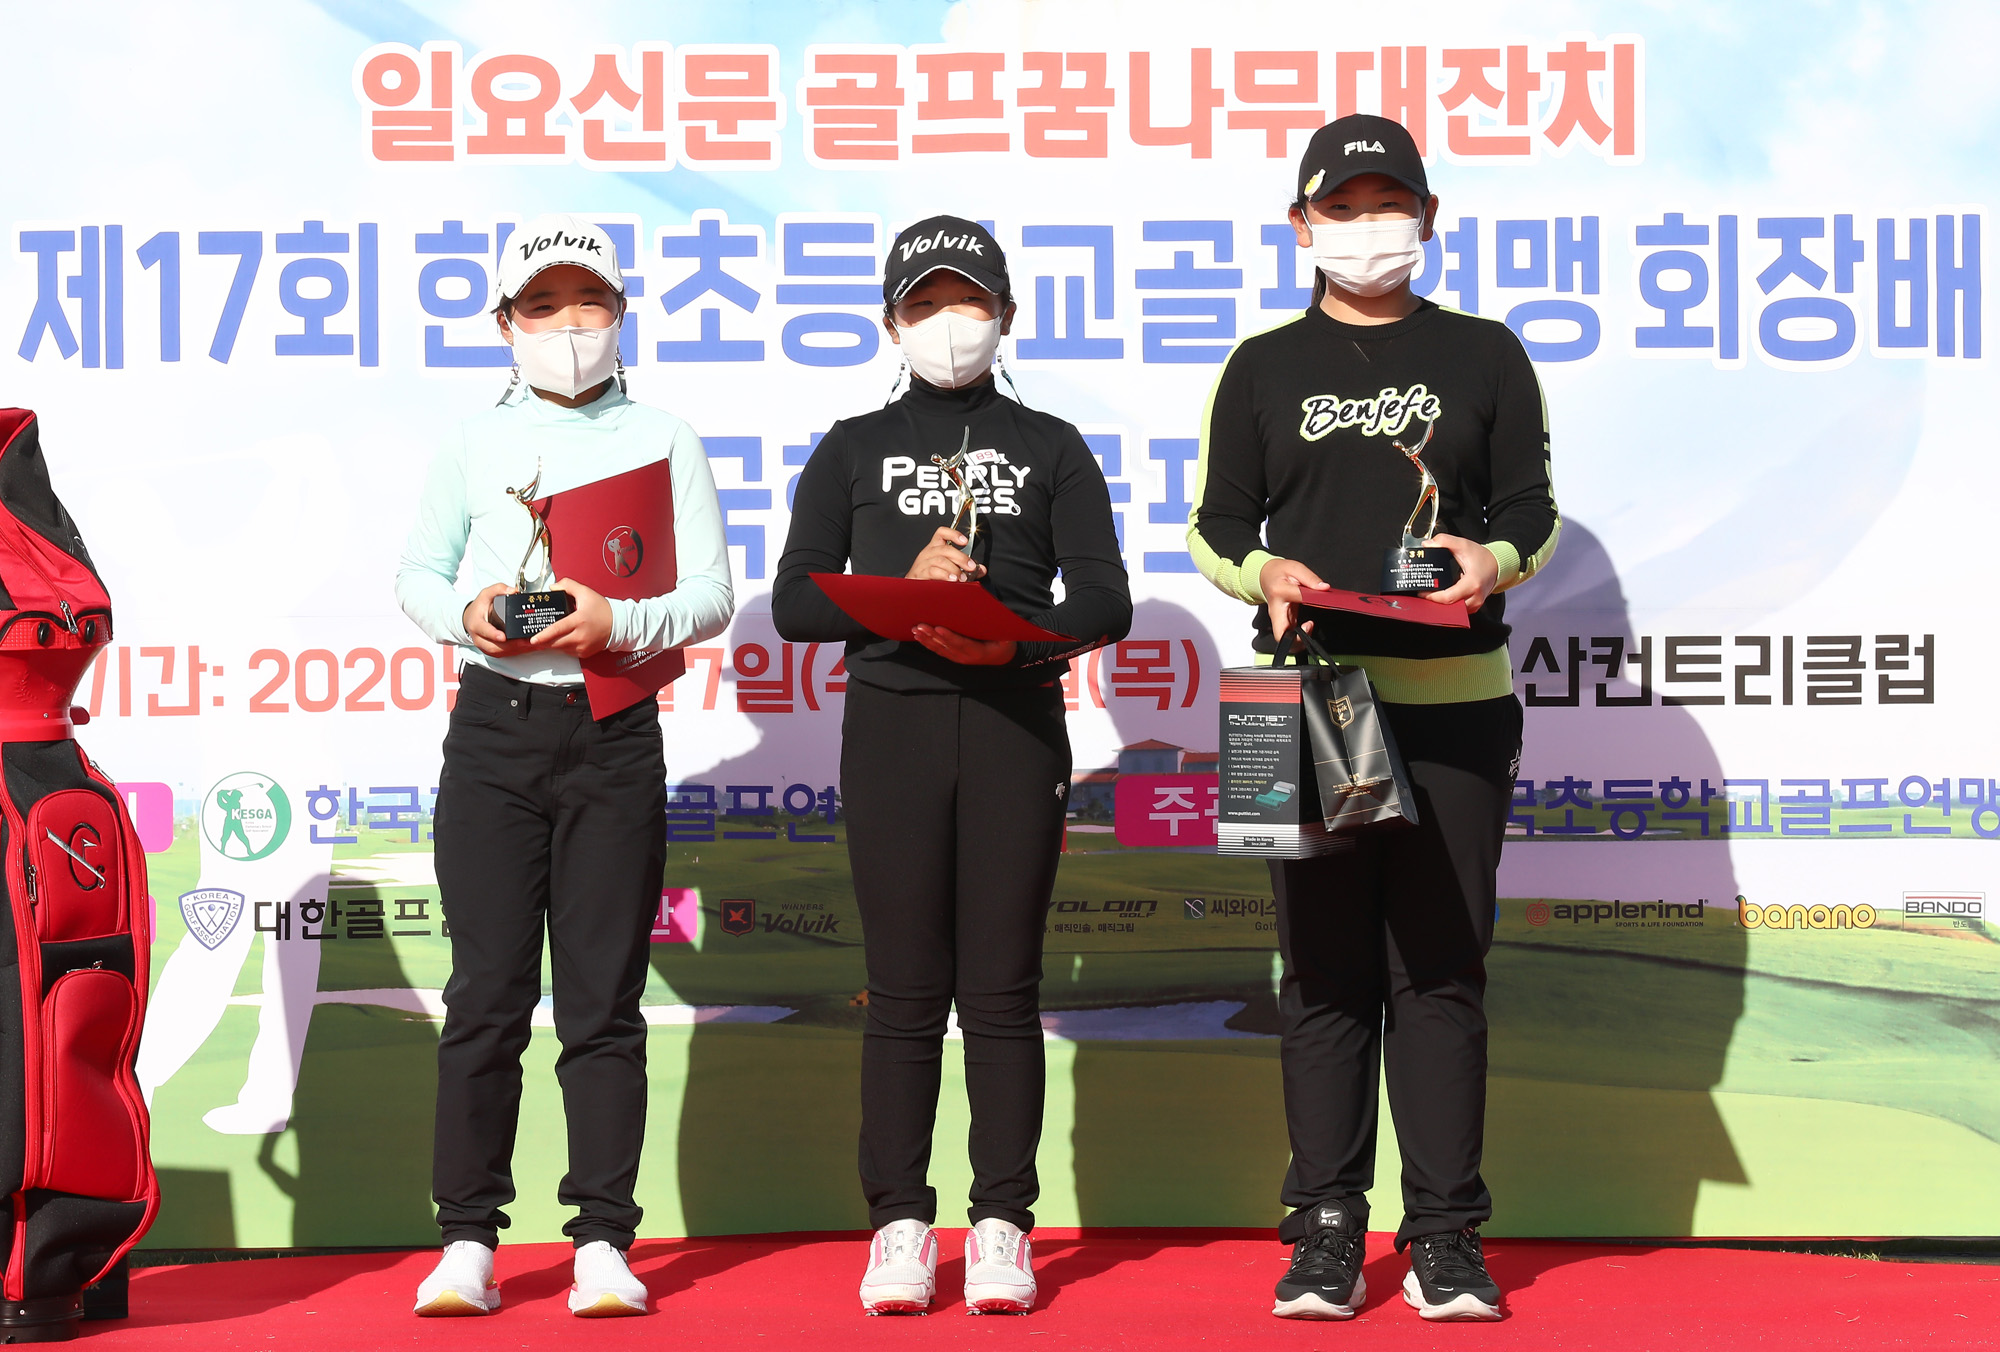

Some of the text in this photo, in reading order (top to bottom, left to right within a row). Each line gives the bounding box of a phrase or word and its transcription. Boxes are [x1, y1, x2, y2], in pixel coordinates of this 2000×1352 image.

[361, 41, 1636, 162] 일요신문 골프꿈나무대잔치
[1344, 140, 1386, 156] FILA
[519, 231, 603, 261] Volvik
[899, 229, 985, 262] Volvik
[17, 220, 380, 370] 제17회
[1635, 212, 1981, 362] 회장배
[1303, 386, 1439, 438] Benjefe
[976, 450, 994, 461] 89
[89, 645, 224, 717] 기간:
[1520, 634, 1934, 707] 산컨트리클럽
[1228, 714, 1288, 722] PUTTIST
[231, 808, 273, 820] KESGA
[193, 892, 229, 901] KOREA
[1905, 901, 1982, 914] BANDO
[184, 903, 239, 944] GOLF ASSOCIATION
[761, 913, 841, 934] Volvik
[1553, 899, 1704, 923] applerind
[1735, 895, 1876, 929] banano
